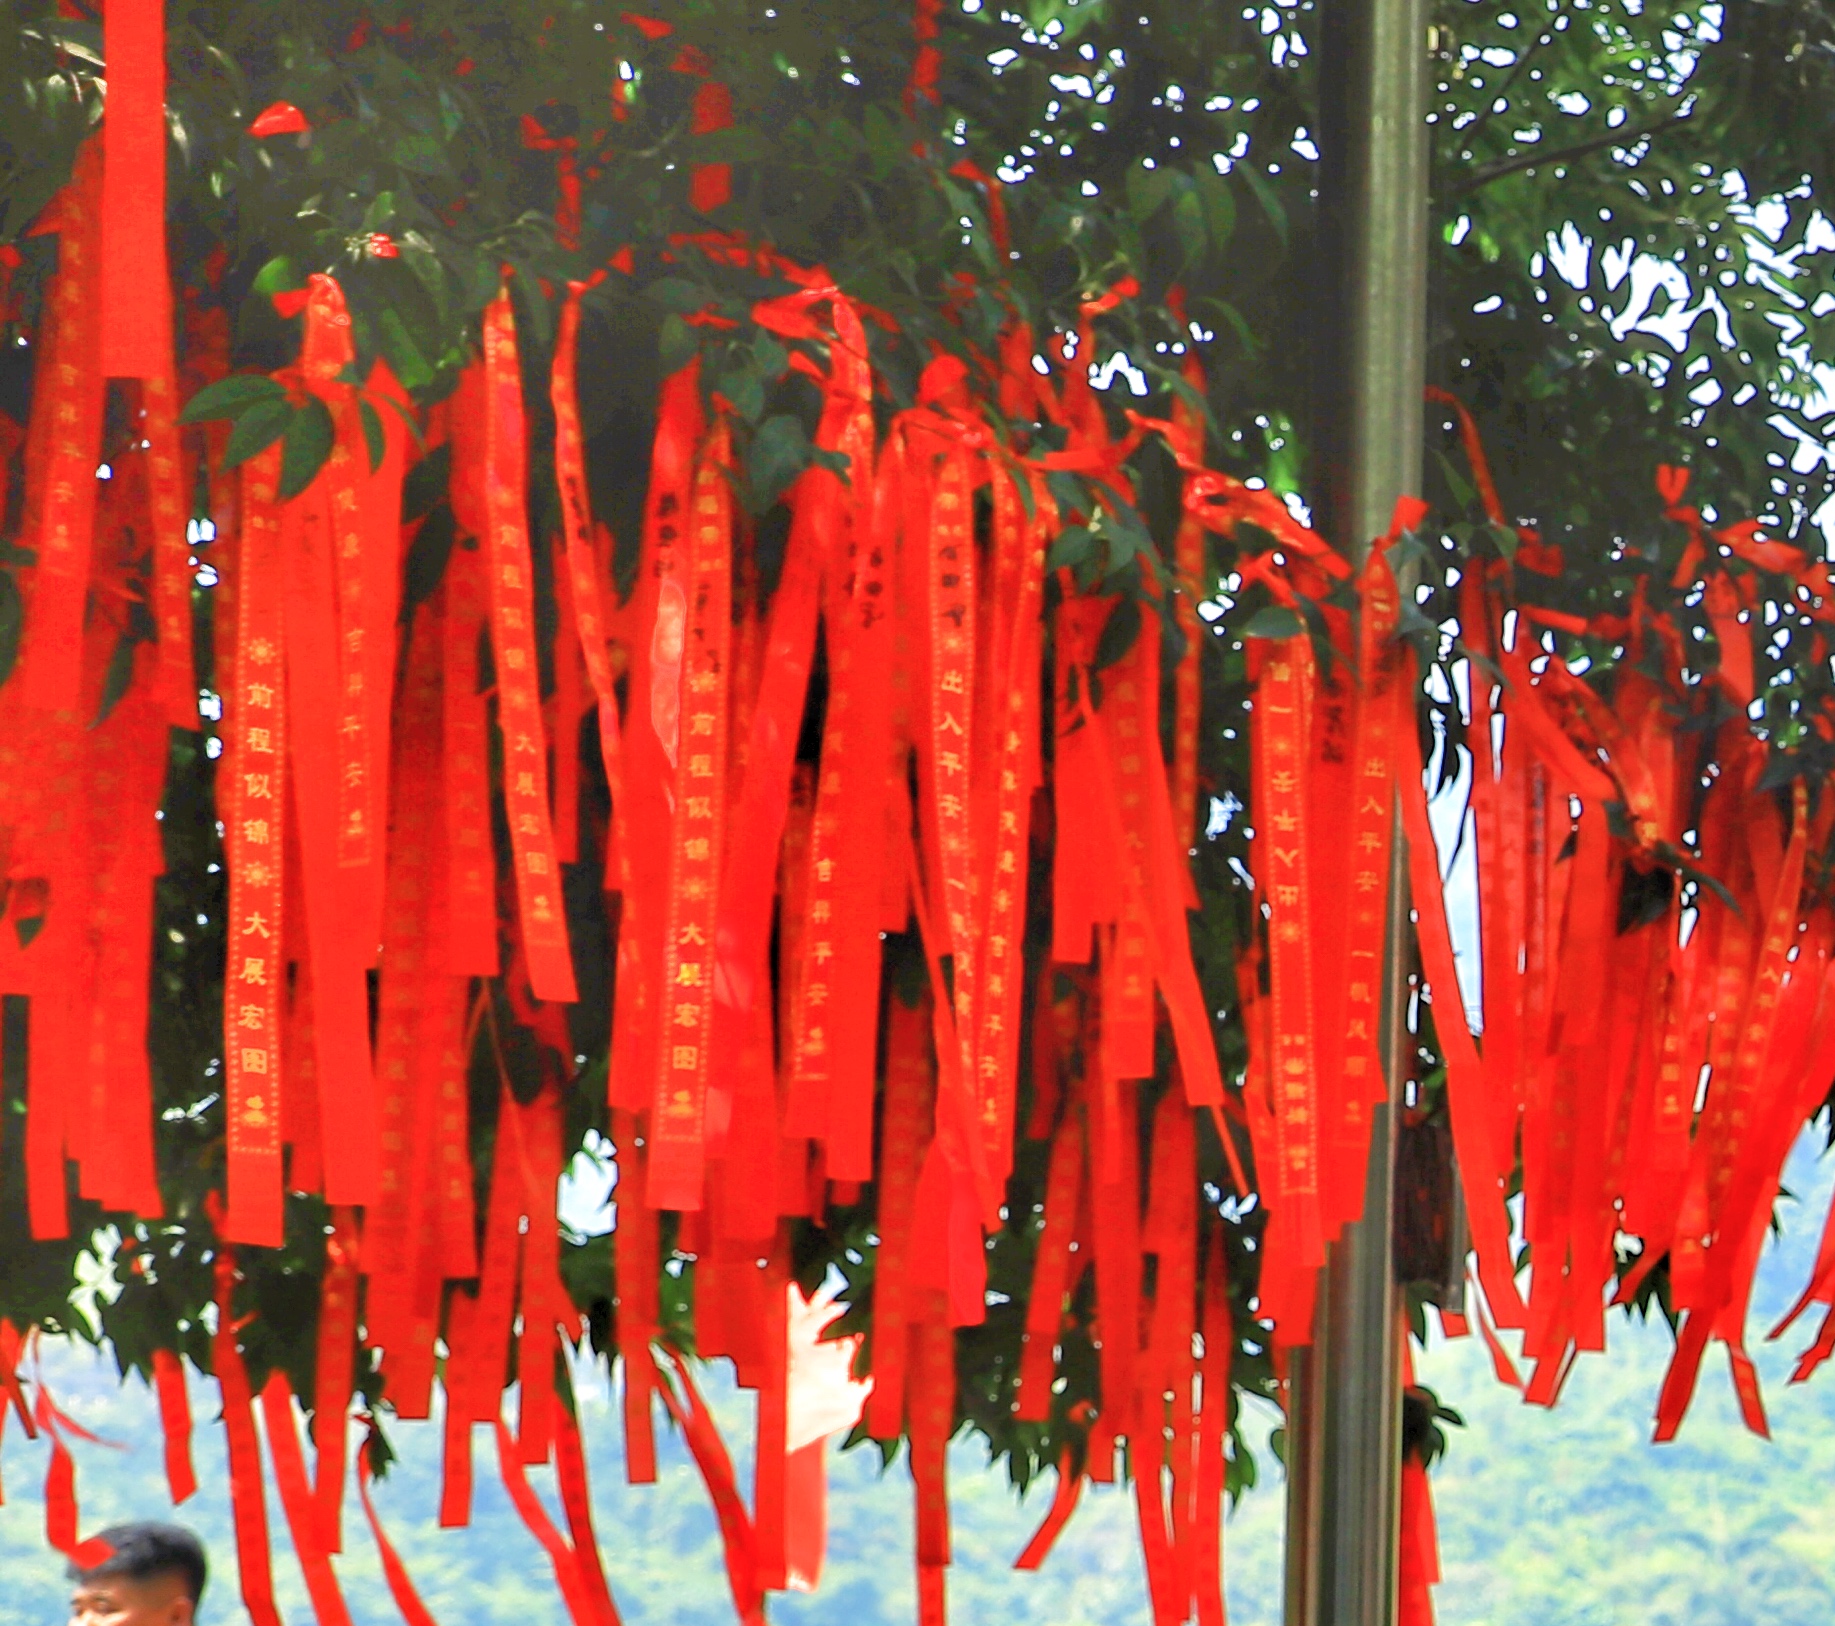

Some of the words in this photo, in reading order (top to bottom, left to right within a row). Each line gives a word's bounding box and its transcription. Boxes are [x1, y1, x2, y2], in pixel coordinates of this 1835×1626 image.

[244, 684, 276, 844] 前程似锦
[515, 733, 549, 874] 大展宏图
[684, 713, 716, 861] 前程似锦
[938, 671, 965, 818] 出入平安
[1355, 758, 1386, 891] 出入平安
[238, 912, 271, 1074] 大展宏图
[672, 922, 706, 1071] 大展宏图
[807, 858, 833, 1006] 吉祥平安
